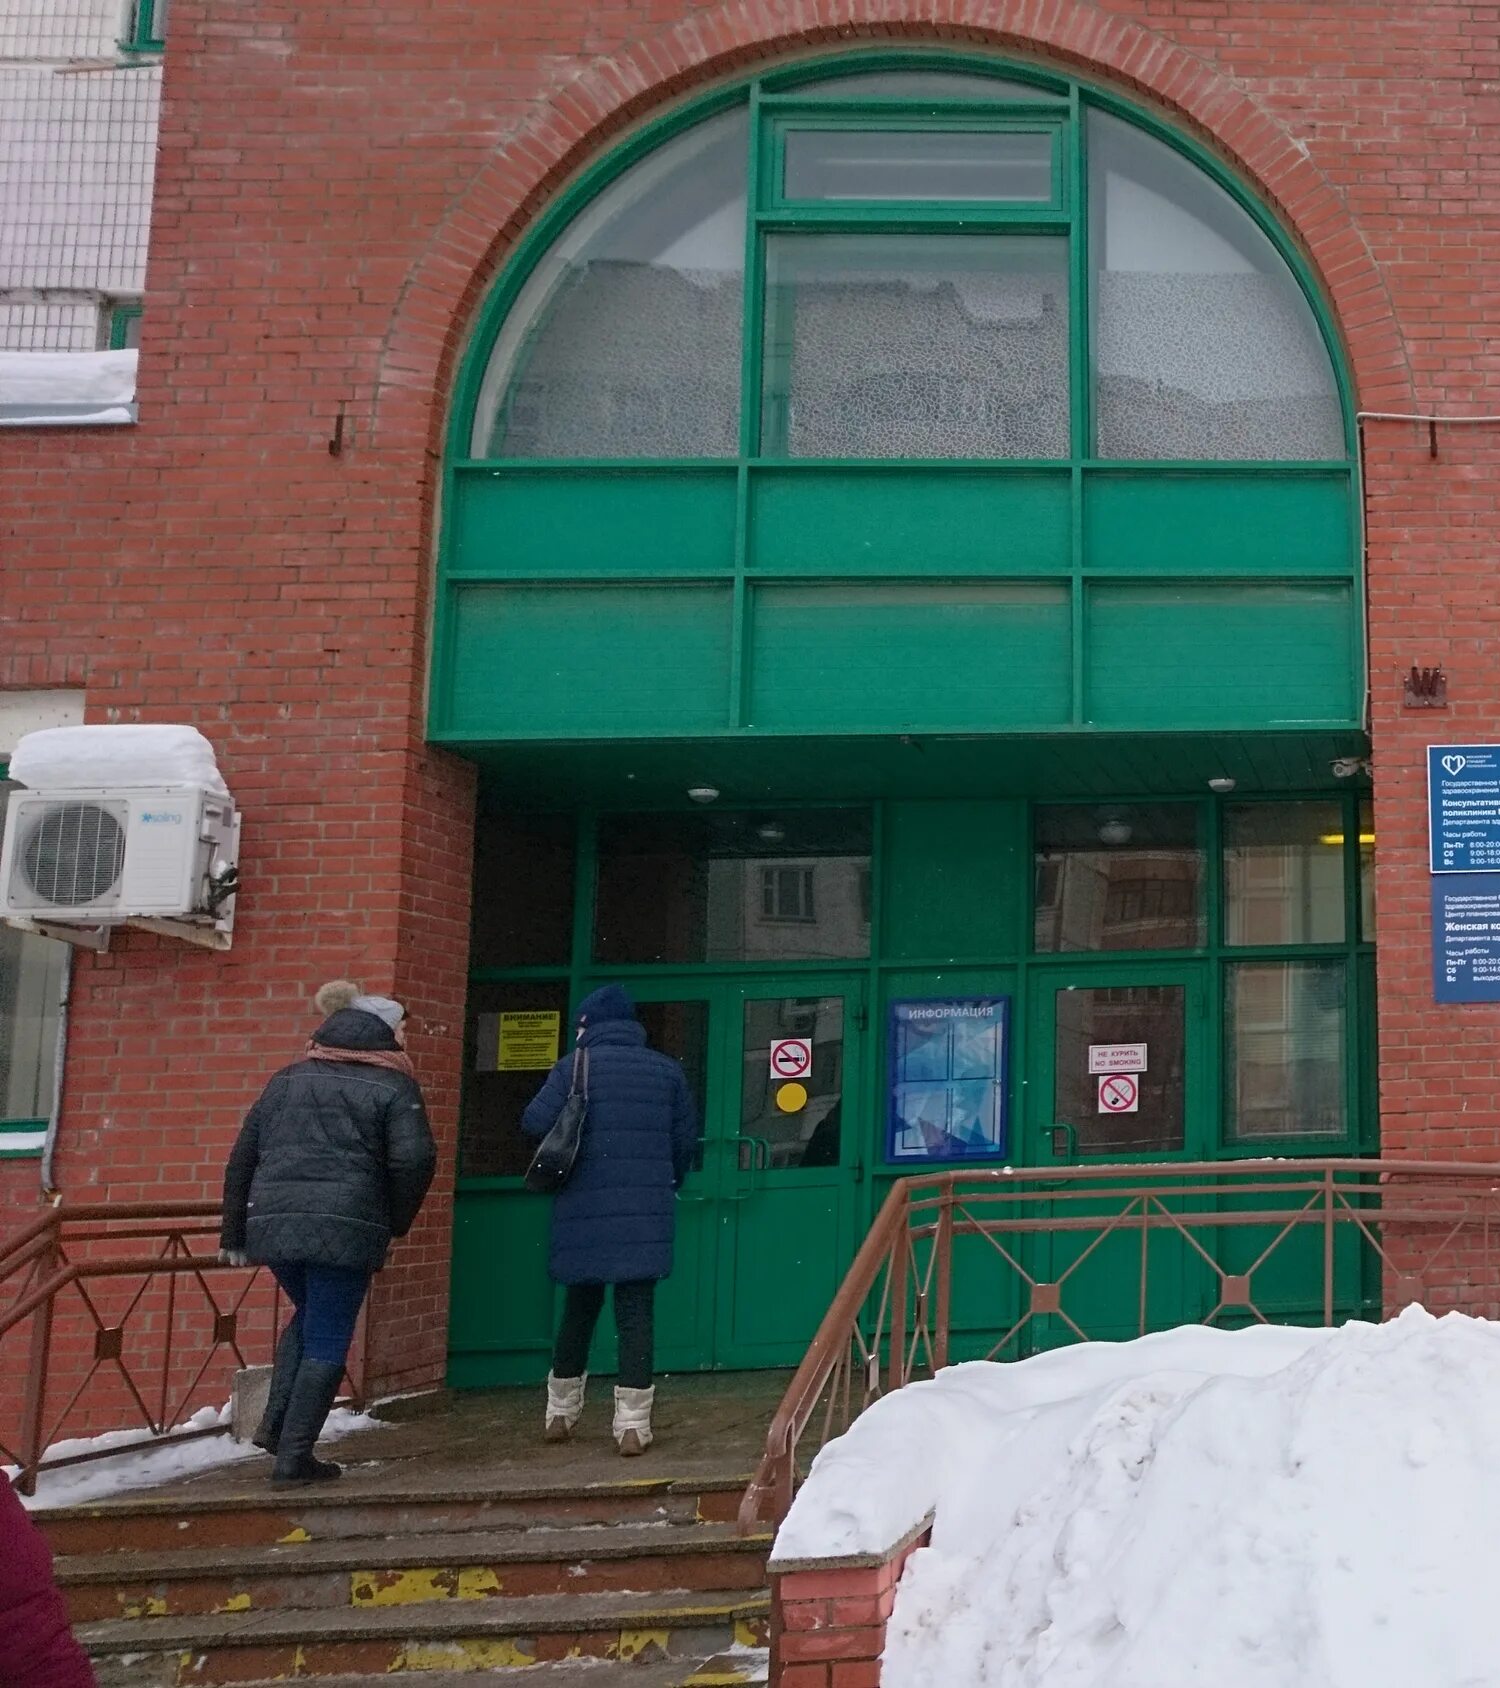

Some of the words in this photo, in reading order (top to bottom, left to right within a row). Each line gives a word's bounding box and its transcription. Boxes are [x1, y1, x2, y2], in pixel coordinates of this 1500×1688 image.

[1445, 922, 1488, 931] Женская
[1465, 947, 1489, 955] работы
[908, 1007, 993, 1019] ИНФОРМАЦИЯ
